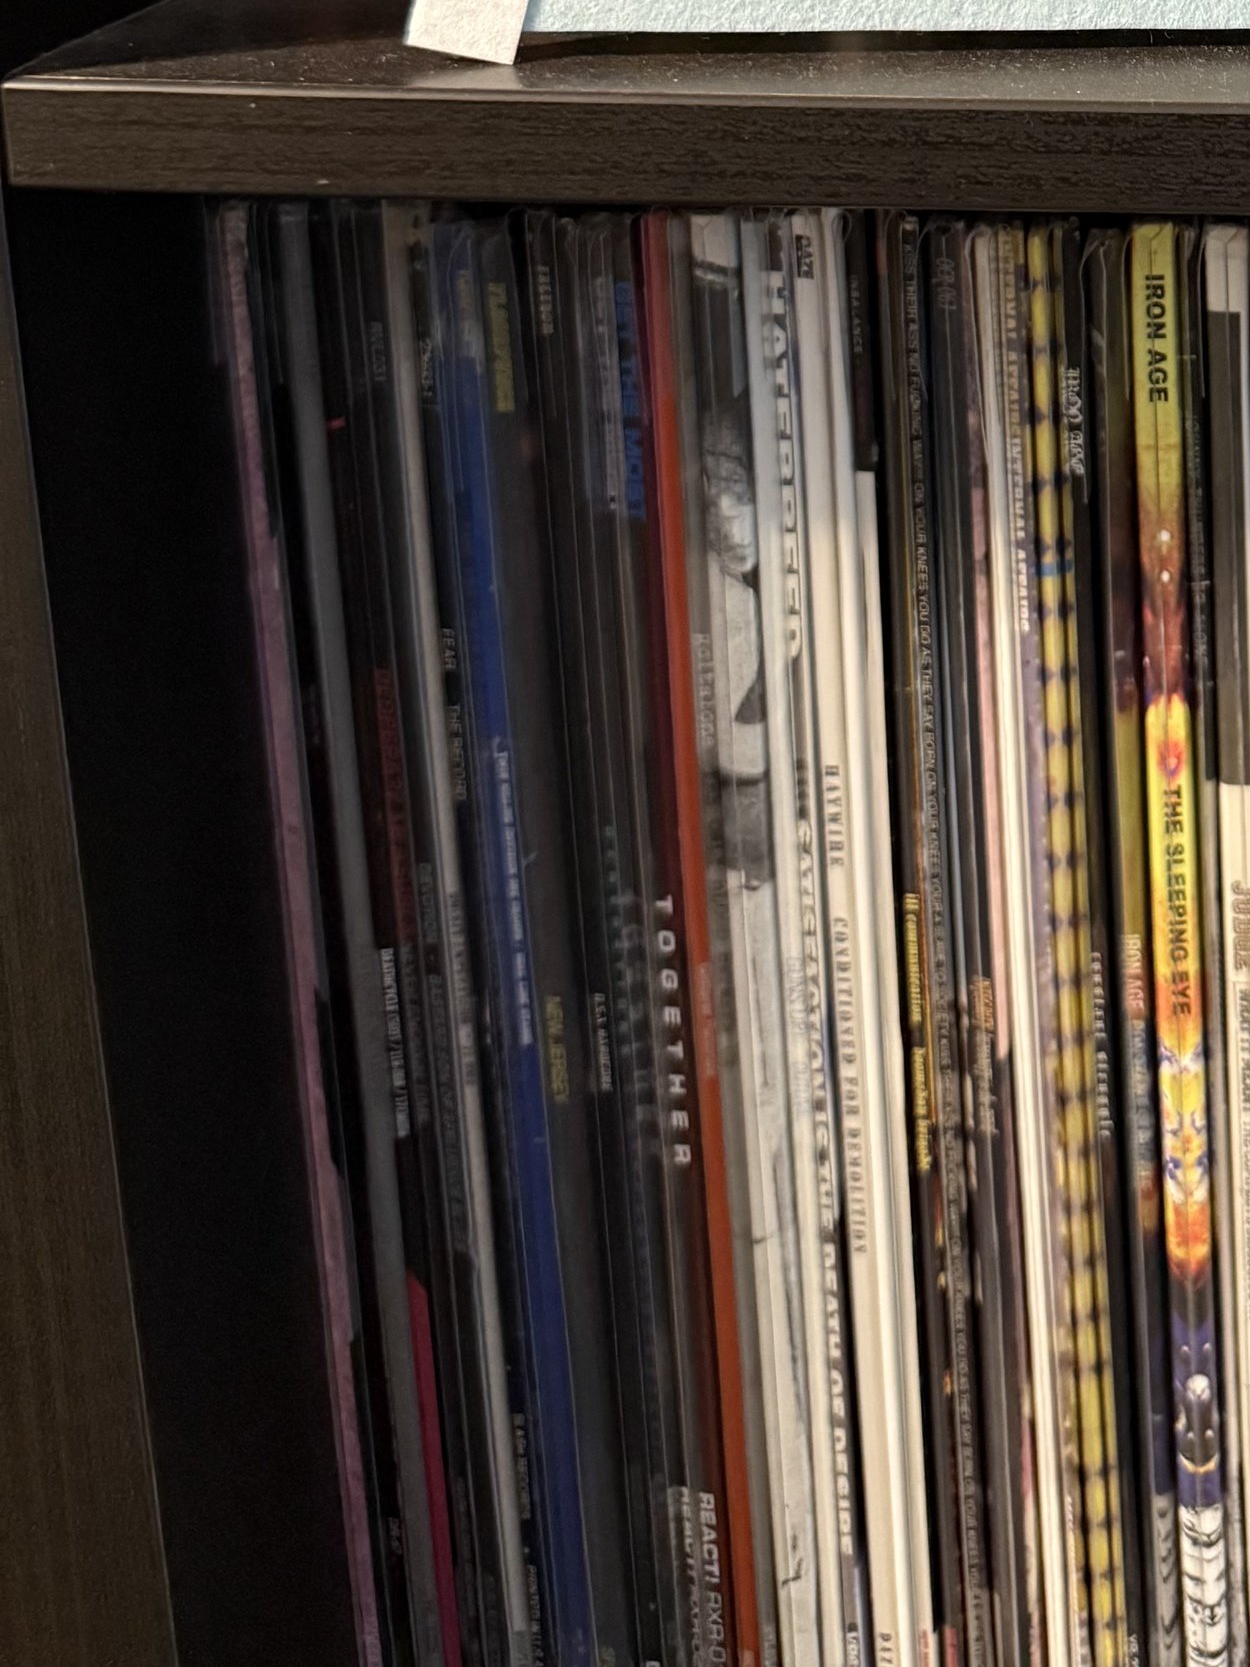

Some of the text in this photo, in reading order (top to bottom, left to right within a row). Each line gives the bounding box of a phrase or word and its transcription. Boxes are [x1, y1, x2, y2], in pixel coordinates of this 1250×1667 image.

[442, 628, 458, 670] FEAR
[916, 546, 934, 702] KNEES YOU DO AS THEY
[1145, 274, 1192, 1018] IRON AGE THE SLEEPING EYE
[654, 894, 692, 1167] TOGETHER
[824, 765, 868, 1255] HAYWIRE CONDITIONED FOR DEMOLITION
